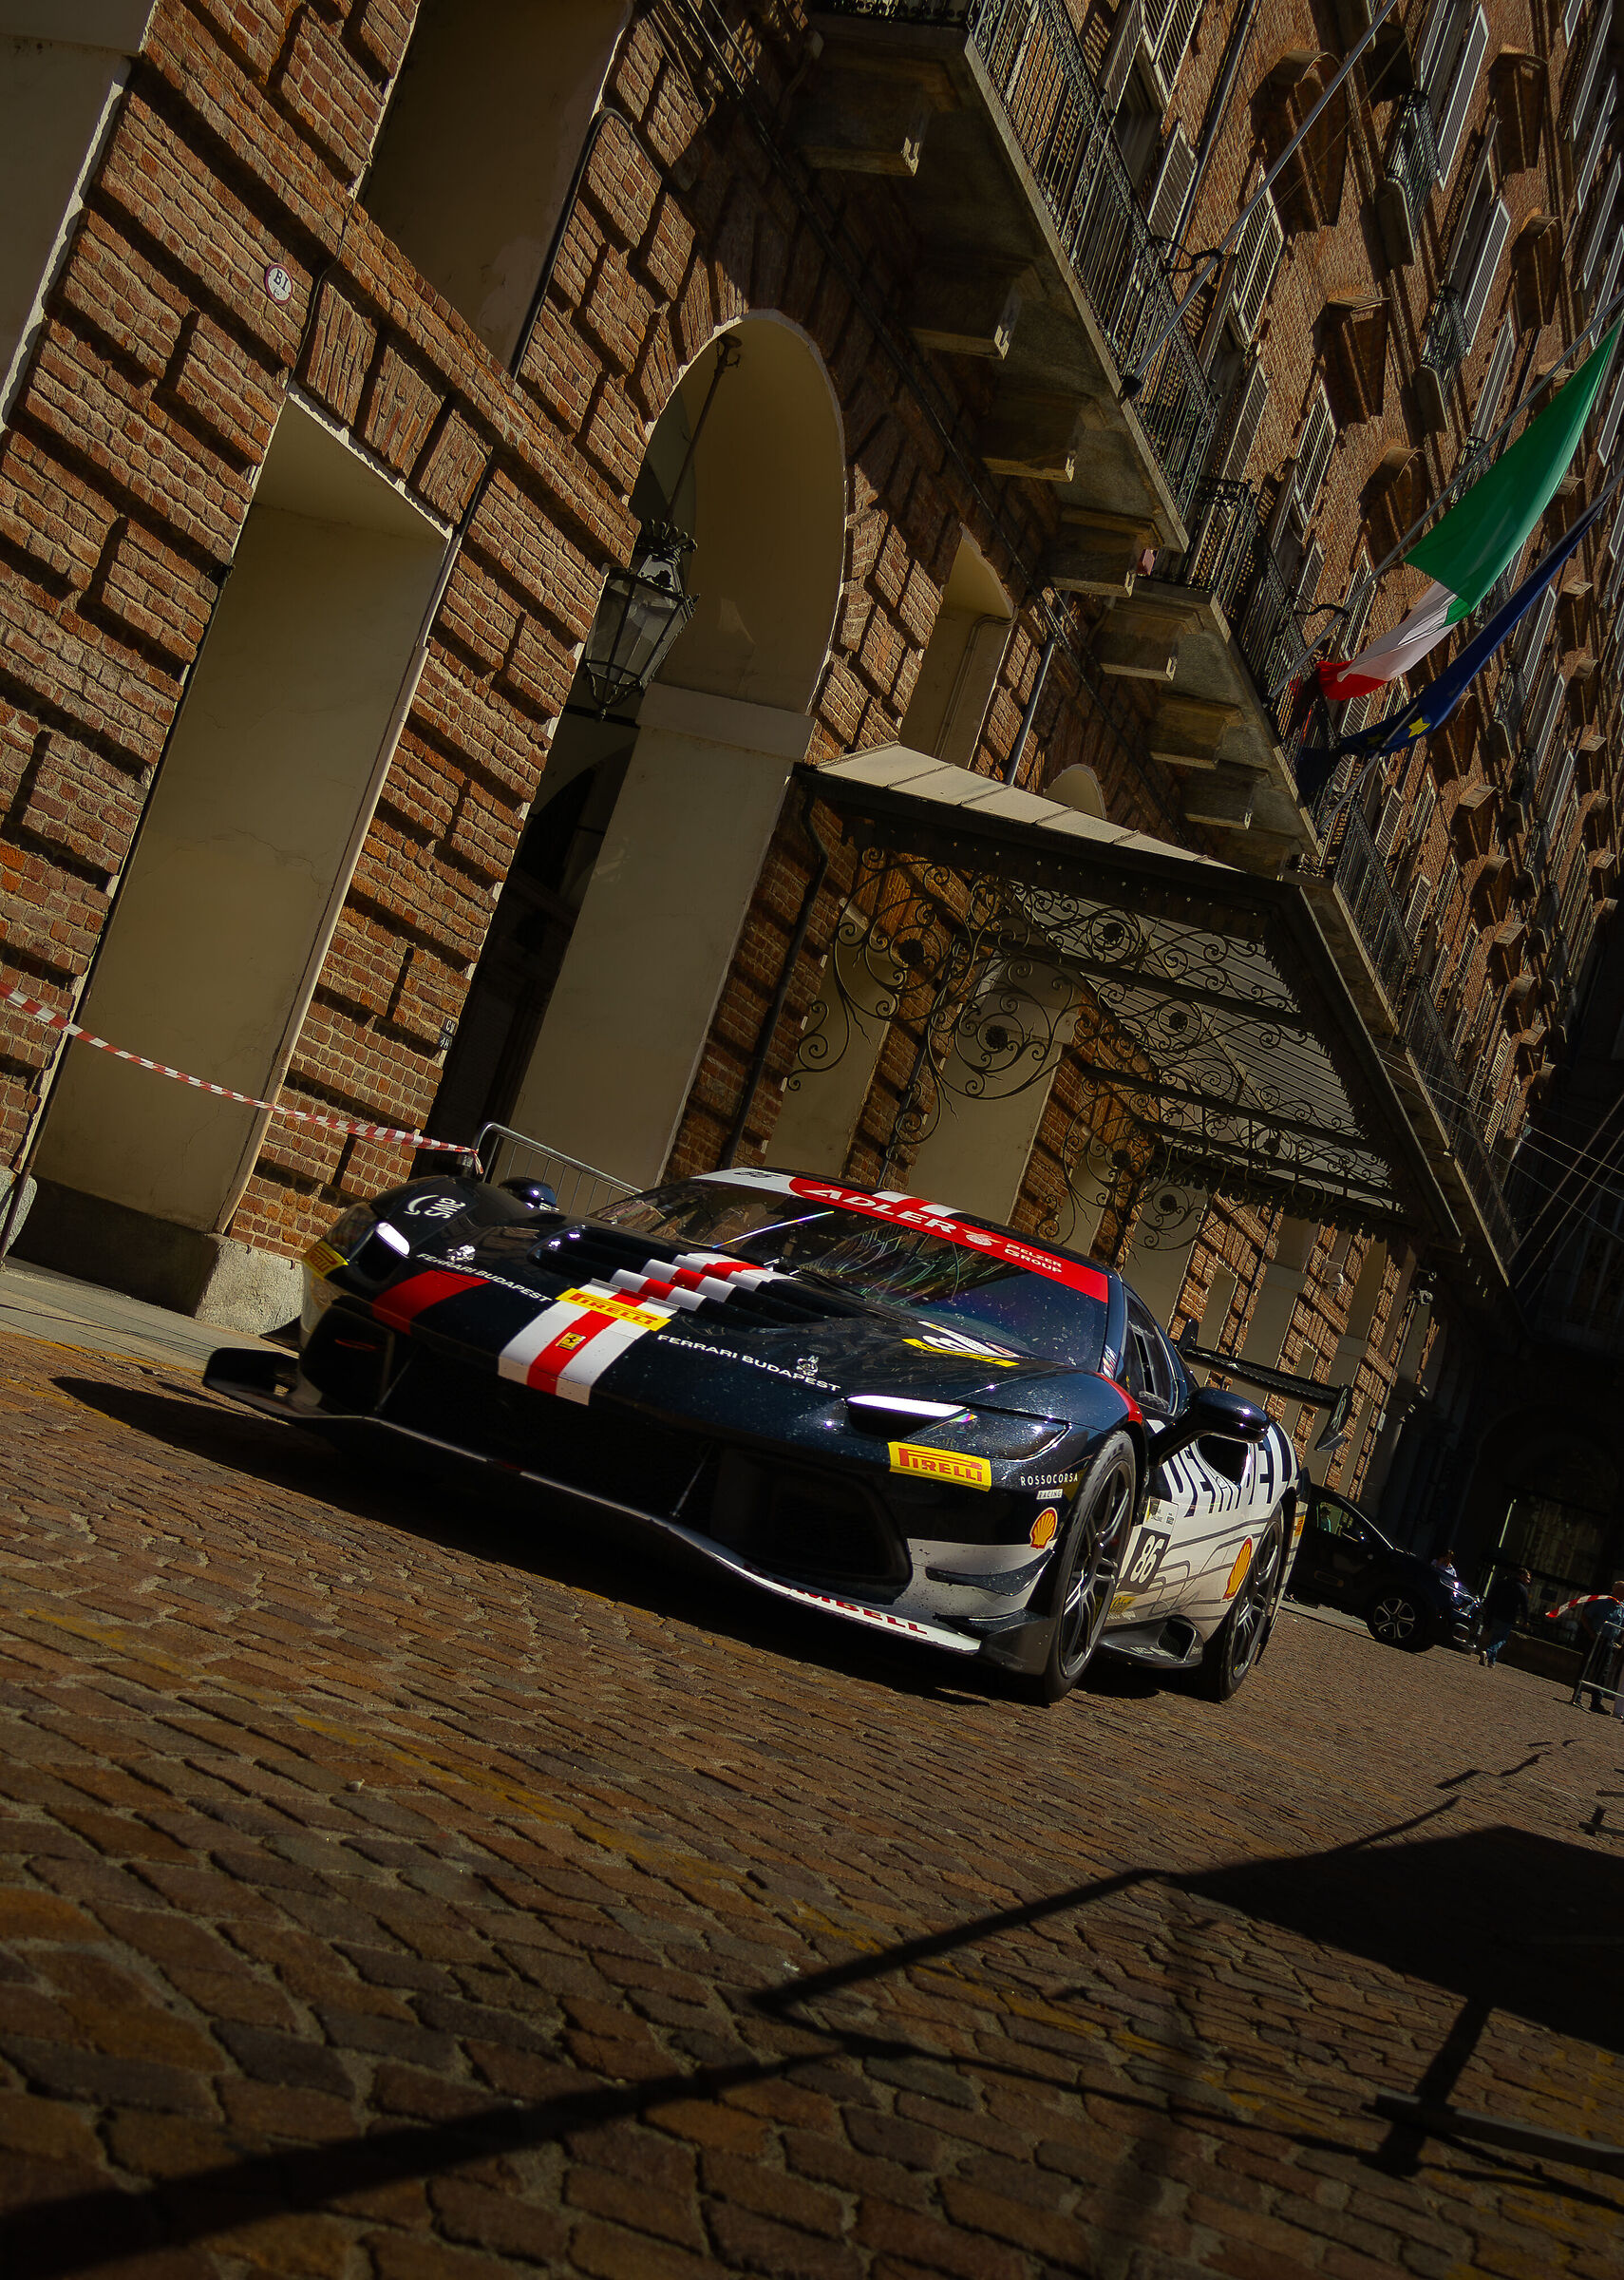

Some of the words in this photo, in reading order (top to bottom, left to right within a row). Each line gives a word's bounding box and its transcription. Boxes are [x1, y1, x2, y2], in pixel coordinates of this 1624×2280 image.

[273, 268, 289, 292] BI
[803, 1188, 958, 1234] ADLER
[1004, 1248, 1063, 1273] GROUP
[1006, 1243, 1063, 1268] PELZER
[416, 1253, 477, 1274] FERRARI
[475, 1270, 553, 1302] BUDAPEST
[568, 1292, 659, 1326] PIRELLI
[656, 1334, 738, 1359] FERRARI
[741, 1355, 842, 1393] BUDAPEST
[898, 1448, 983, 1482] PIRELLI
[1019, 1472, 1079, 1487] ROSSOCORSA
[1038, 1489, 1062, 1499] RACING
[1129, 1534, 1165, 1584] 86
